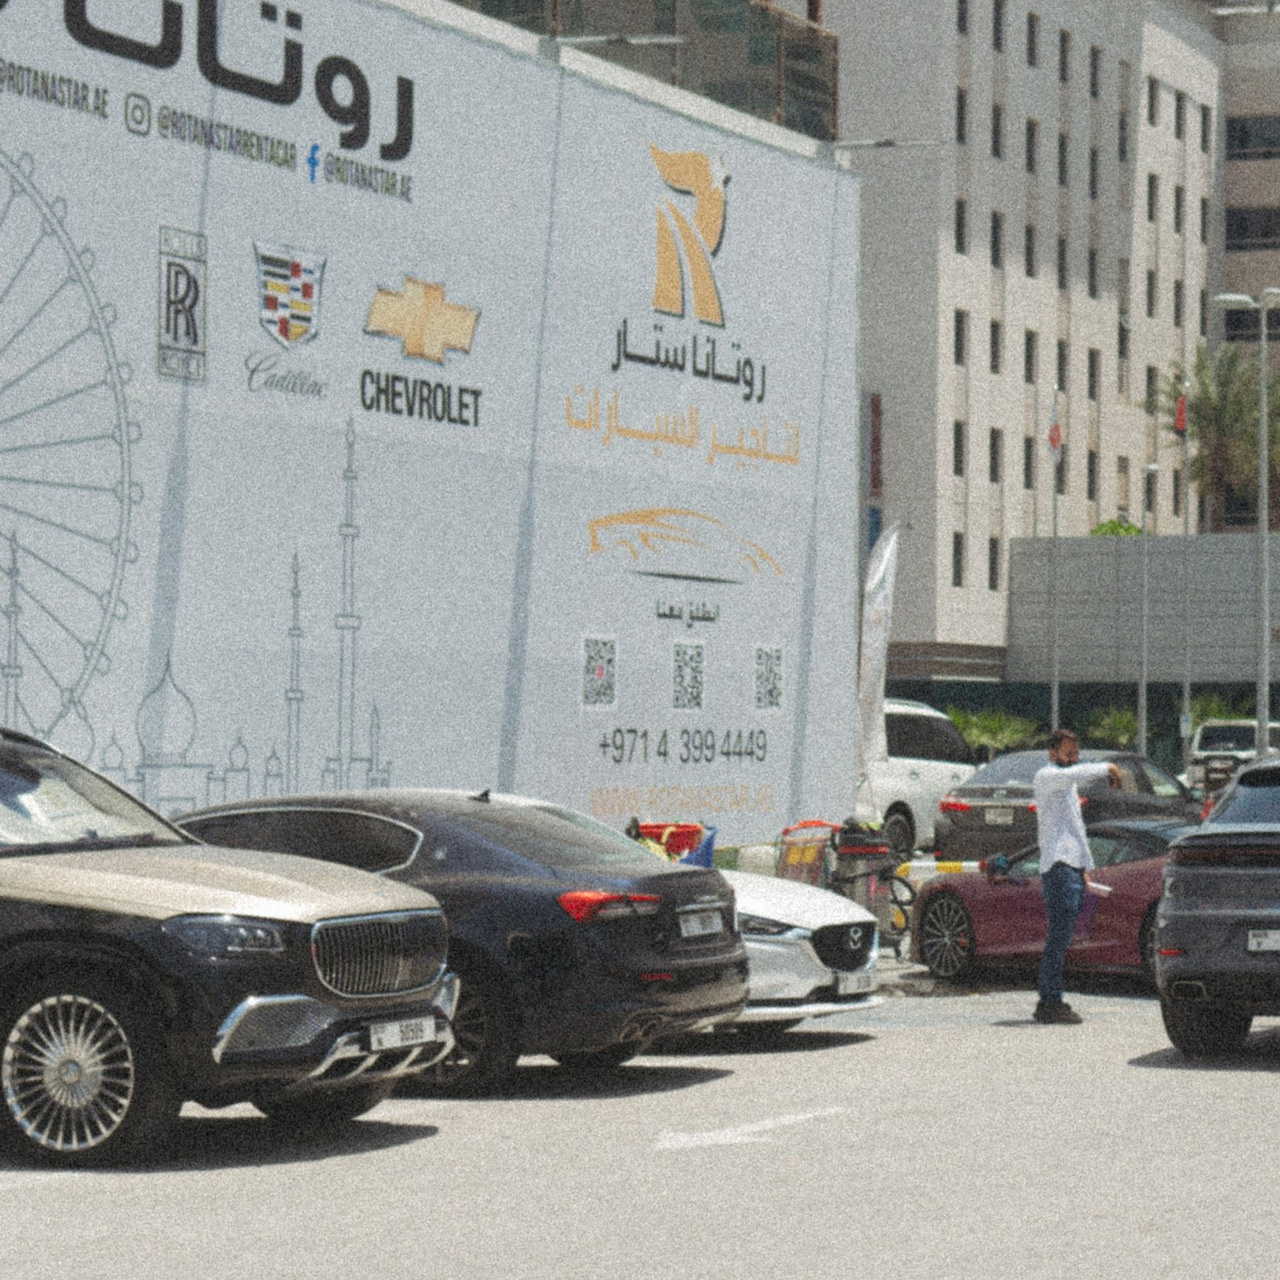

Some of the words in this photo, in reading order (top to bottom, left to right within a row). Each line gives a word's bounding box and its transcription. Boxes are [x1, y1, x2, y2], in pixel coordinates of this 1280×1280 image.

[244, 350, 328, 398] Cadillac
[360, 369, 482, 427] CHEVROLET
[599, 728, 648, 763] +971
[656, 729, 668, 763] 4
[679, 729, 716, 763] 399
[720, 729, 767, 763] 4449
